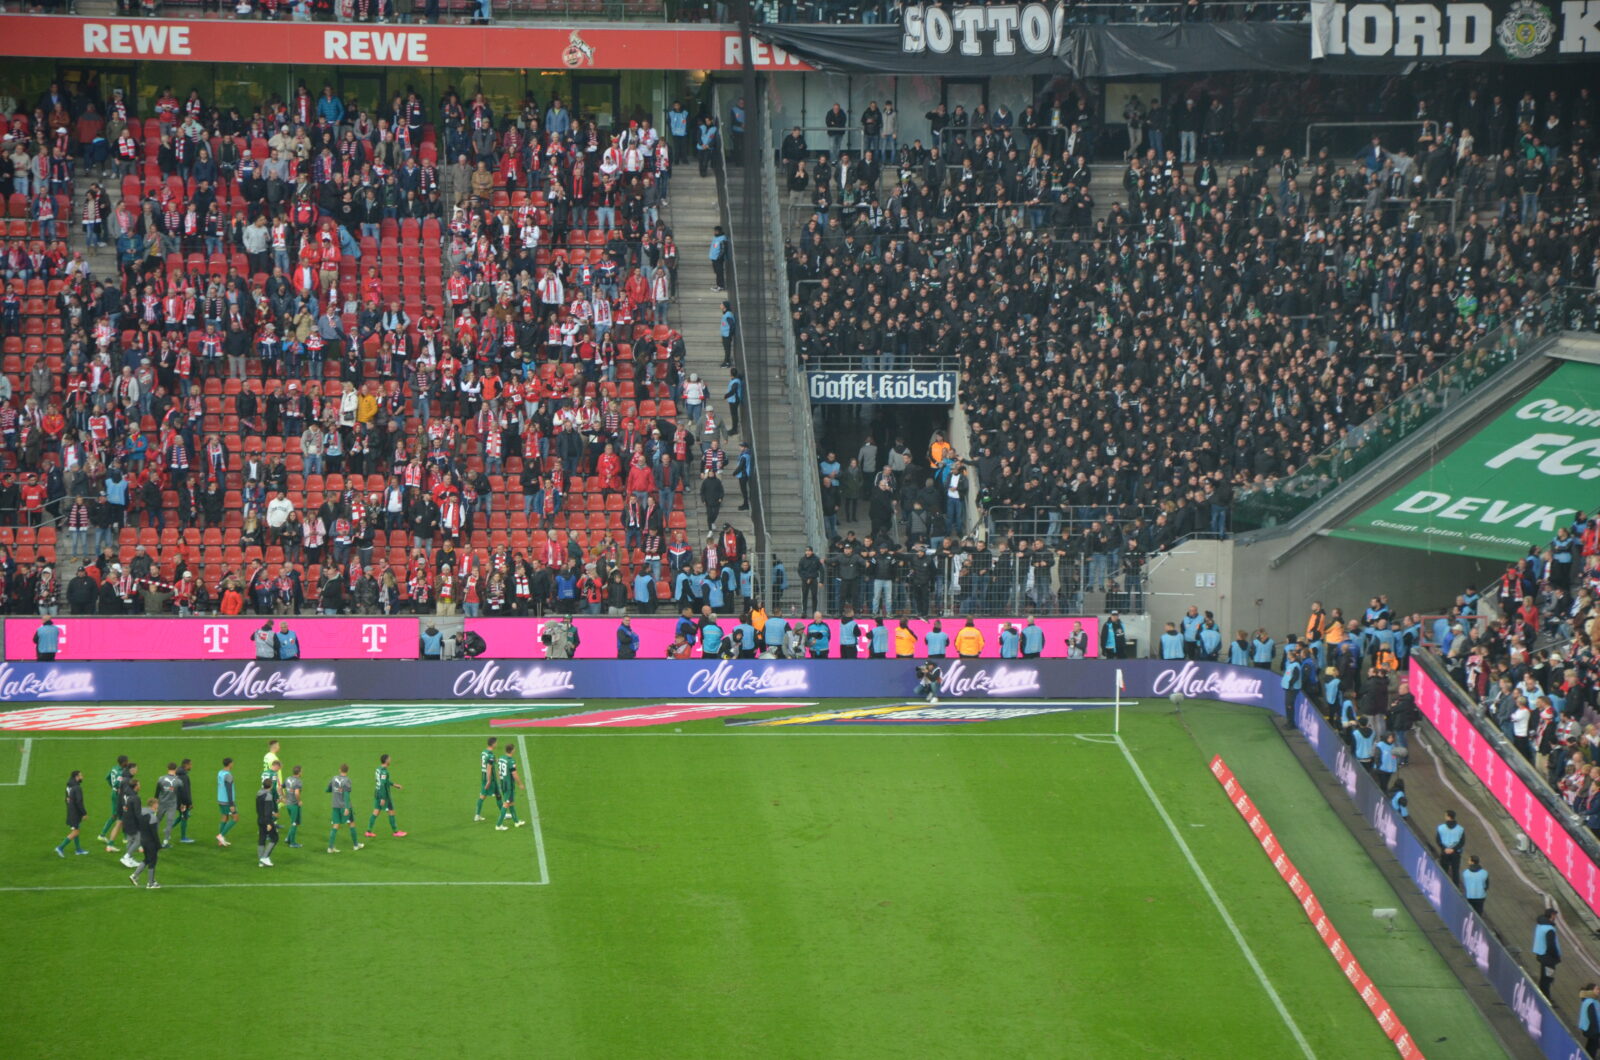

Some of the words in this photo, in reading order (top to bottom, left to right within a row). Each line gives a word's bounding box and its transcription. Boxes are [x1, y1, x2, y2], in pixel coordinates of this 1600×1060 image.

[83, 24, 191, 55] REWE
[323, 30, 428, 62] REWE
[810, 373, 873, 401] Gaffel
[879, 373, 951, 402] Kölsch
[213, 661, 337, 698] Malzkorn
[452, 660, 574, 697] Malzkorn
[687, 660, 809, 697] Malzkorn
[1153, 660, 1263, 698] Malzkorn
